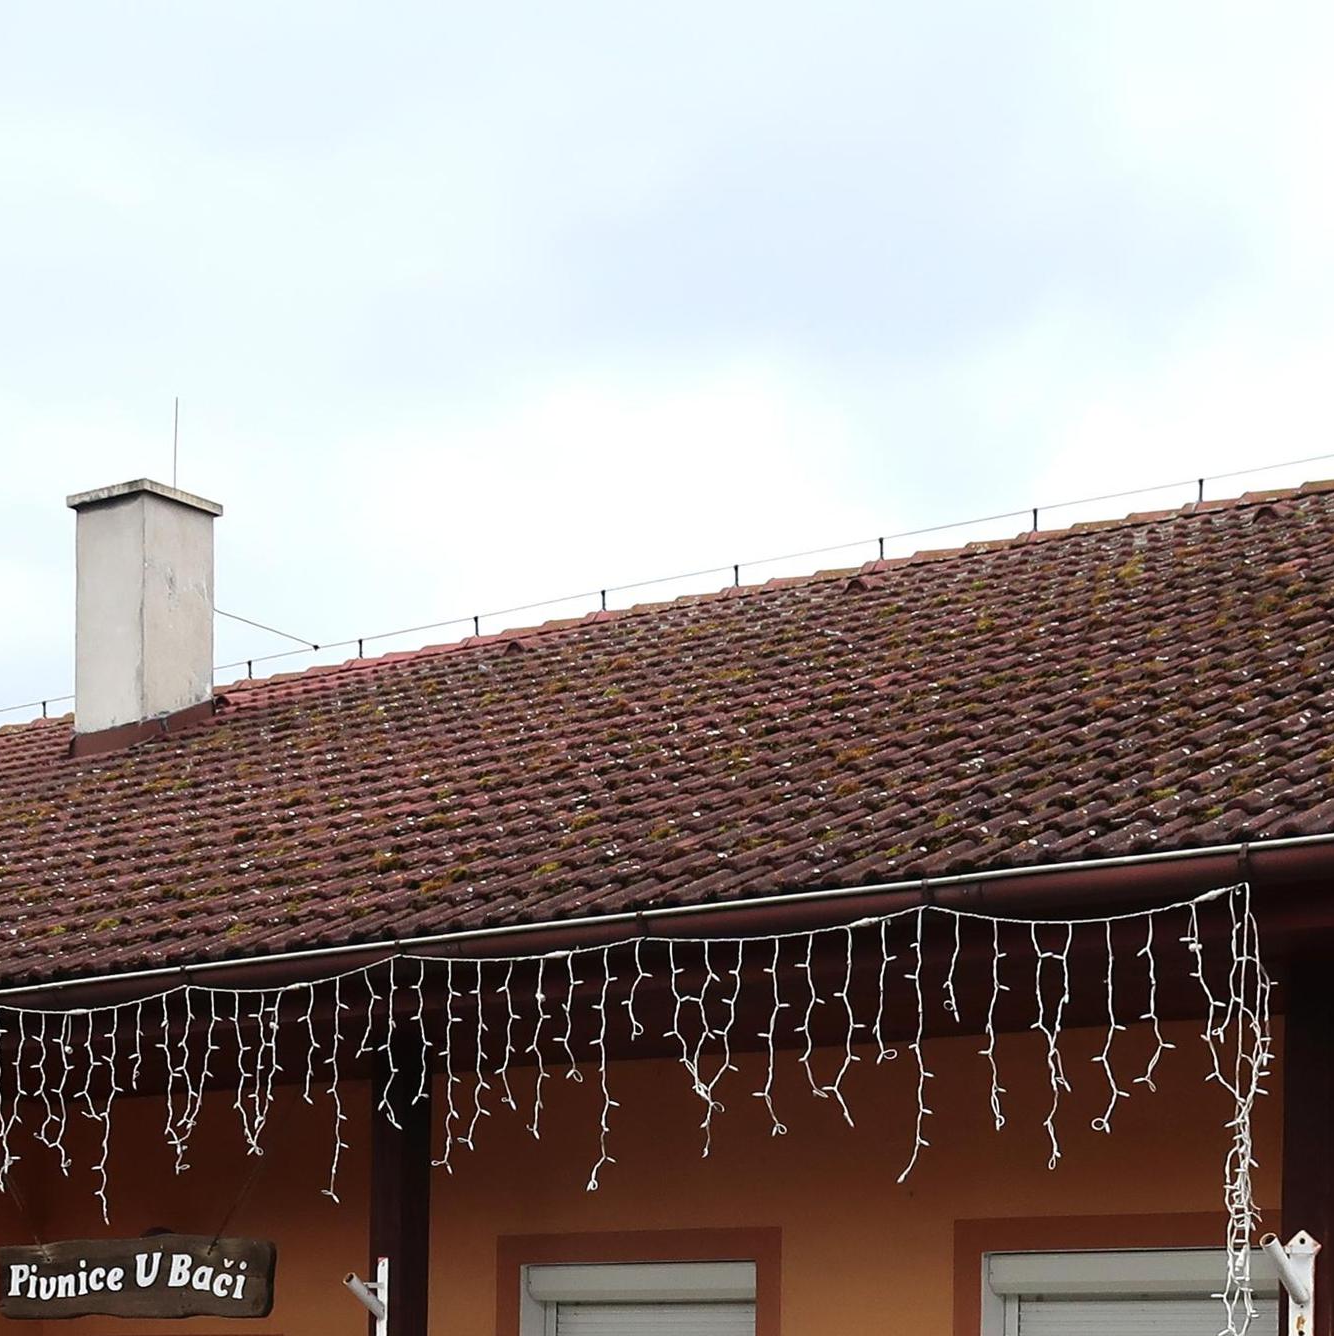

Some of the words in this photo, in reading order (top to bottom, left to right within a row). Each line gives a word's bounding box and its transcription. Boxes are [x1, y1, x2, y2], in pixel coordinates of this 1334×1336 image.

[7, 1260, 124, 1300] Pivnice
[135, 1252, 163, 1287] U
[168, 1252, 248, 1300] Bači
